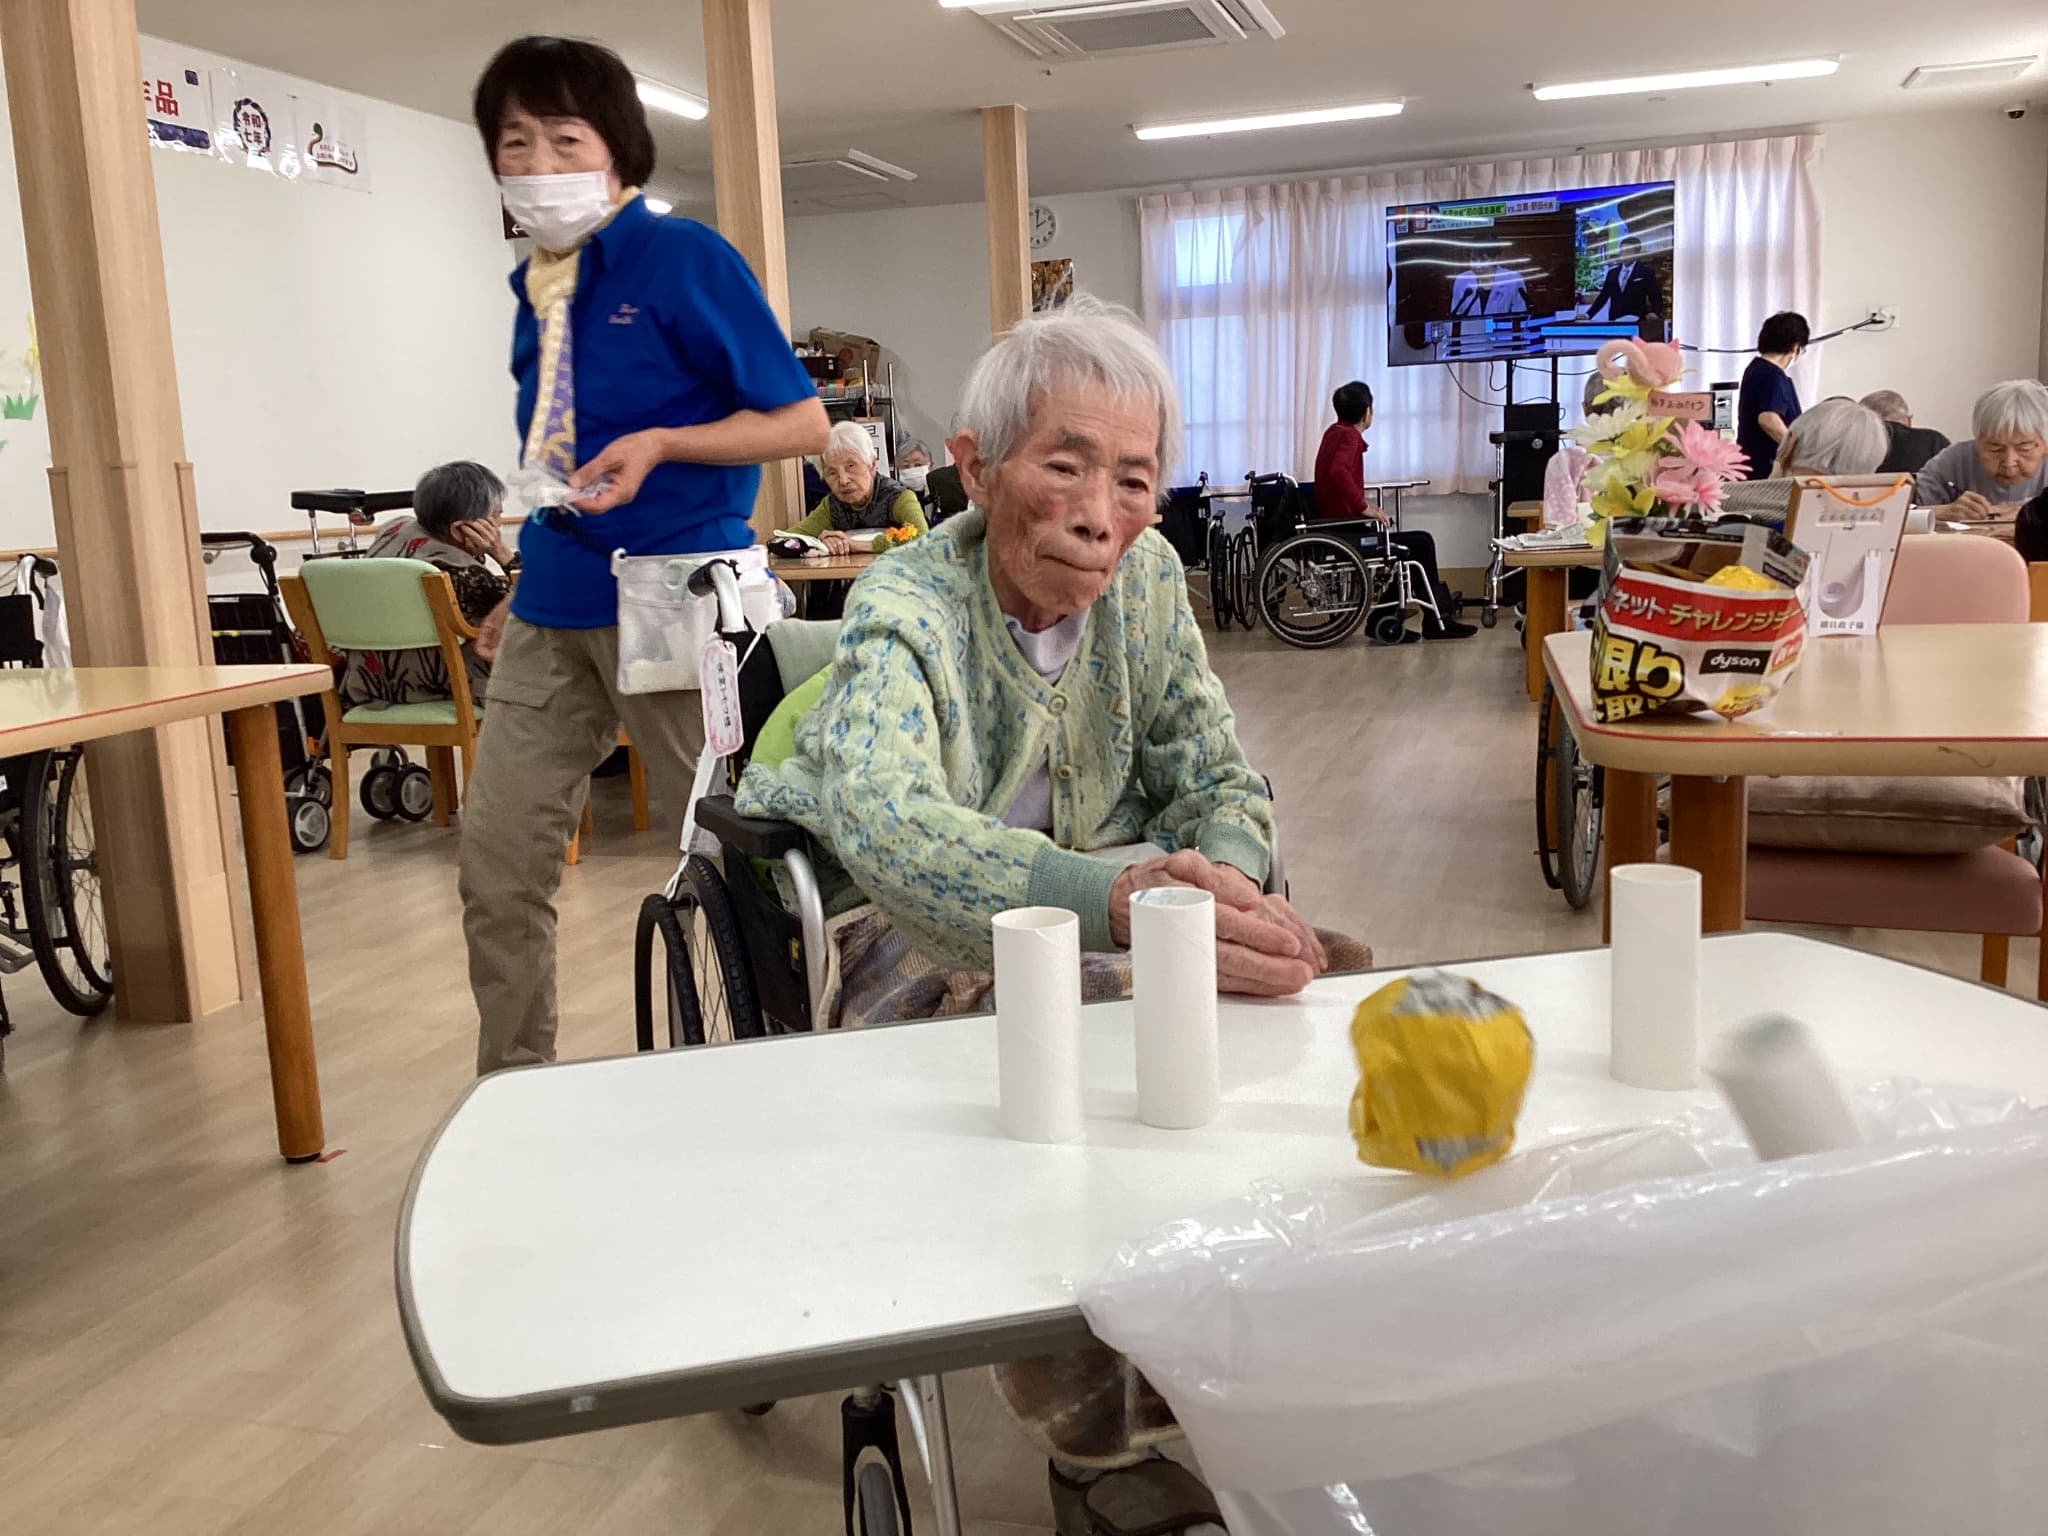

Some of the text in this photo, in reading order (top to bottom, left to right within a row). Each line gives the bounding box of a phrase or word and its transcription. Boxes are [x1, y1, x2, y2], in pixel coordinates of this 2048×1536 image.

[1613, 589, 1666, 620] ネット
[1710, 653, 1761, 669] dyson
